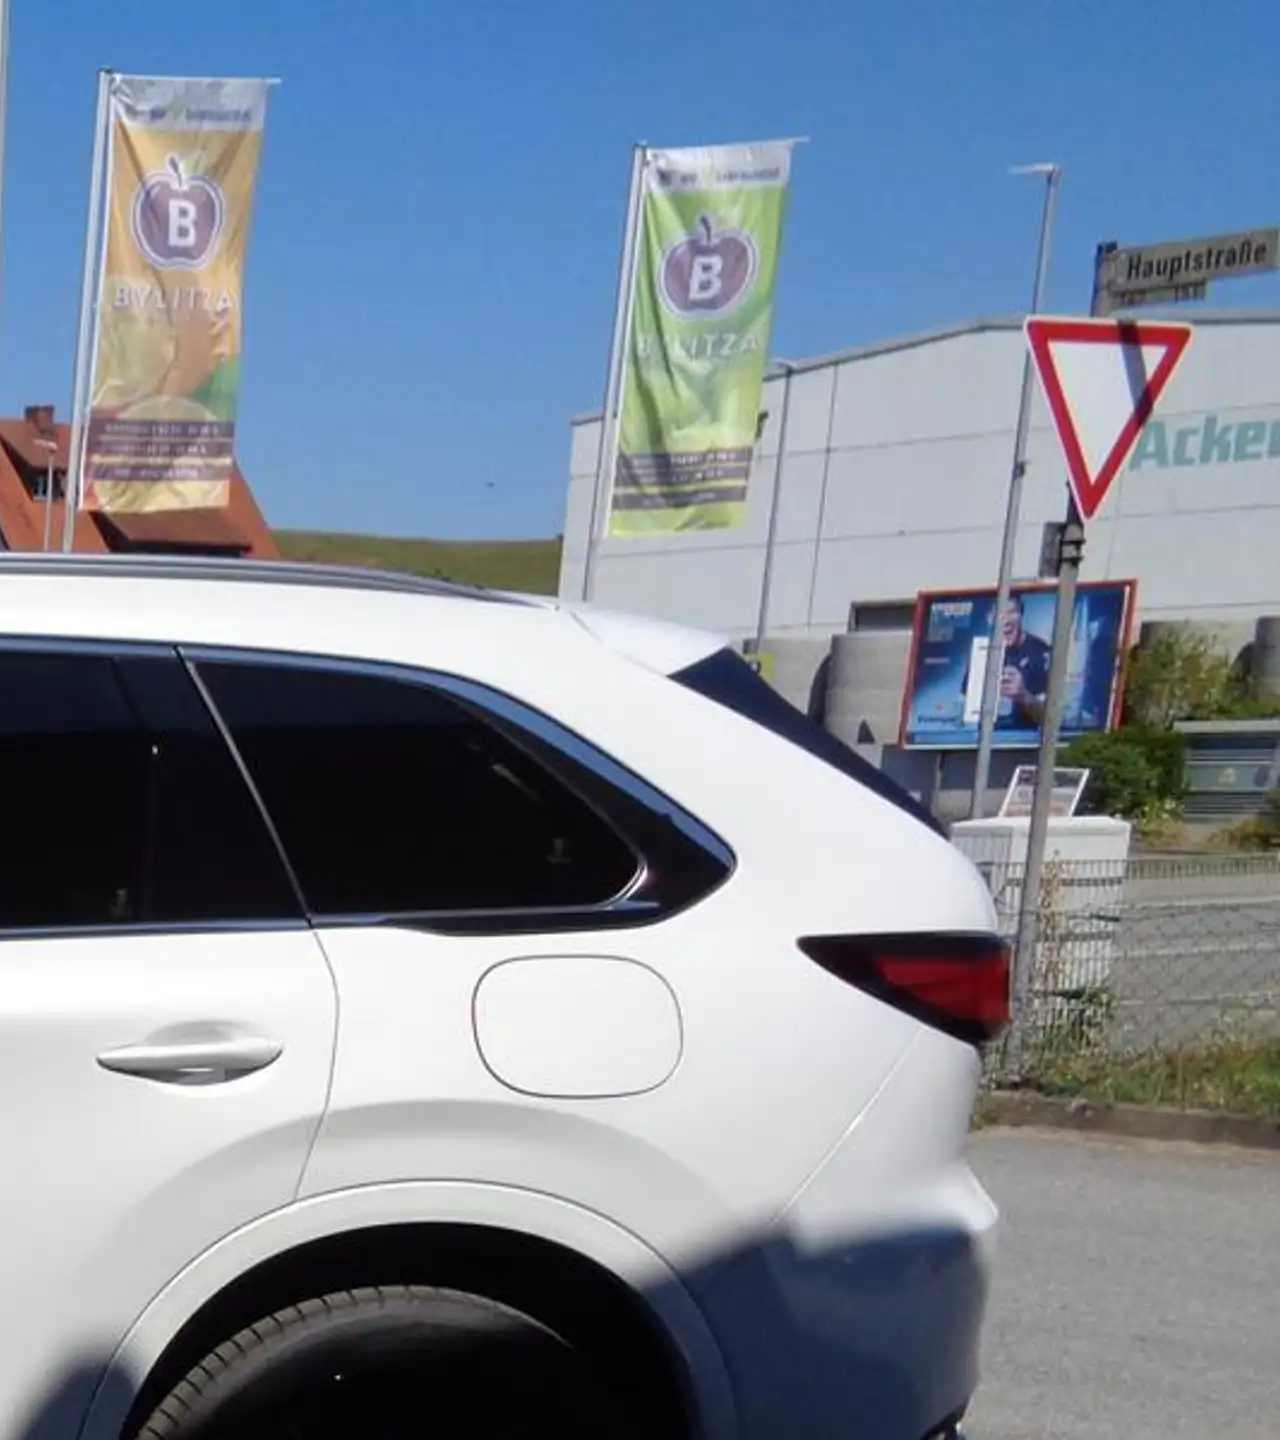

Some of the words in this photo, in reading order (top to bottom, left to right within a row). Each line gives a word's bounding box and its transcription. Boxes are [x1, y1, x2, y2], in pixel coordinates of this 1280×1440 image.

[167, 198, 198, 248] B
[688, 254, 723, 302] B
[1126, 238, 1268, 282] Hauptstraße
